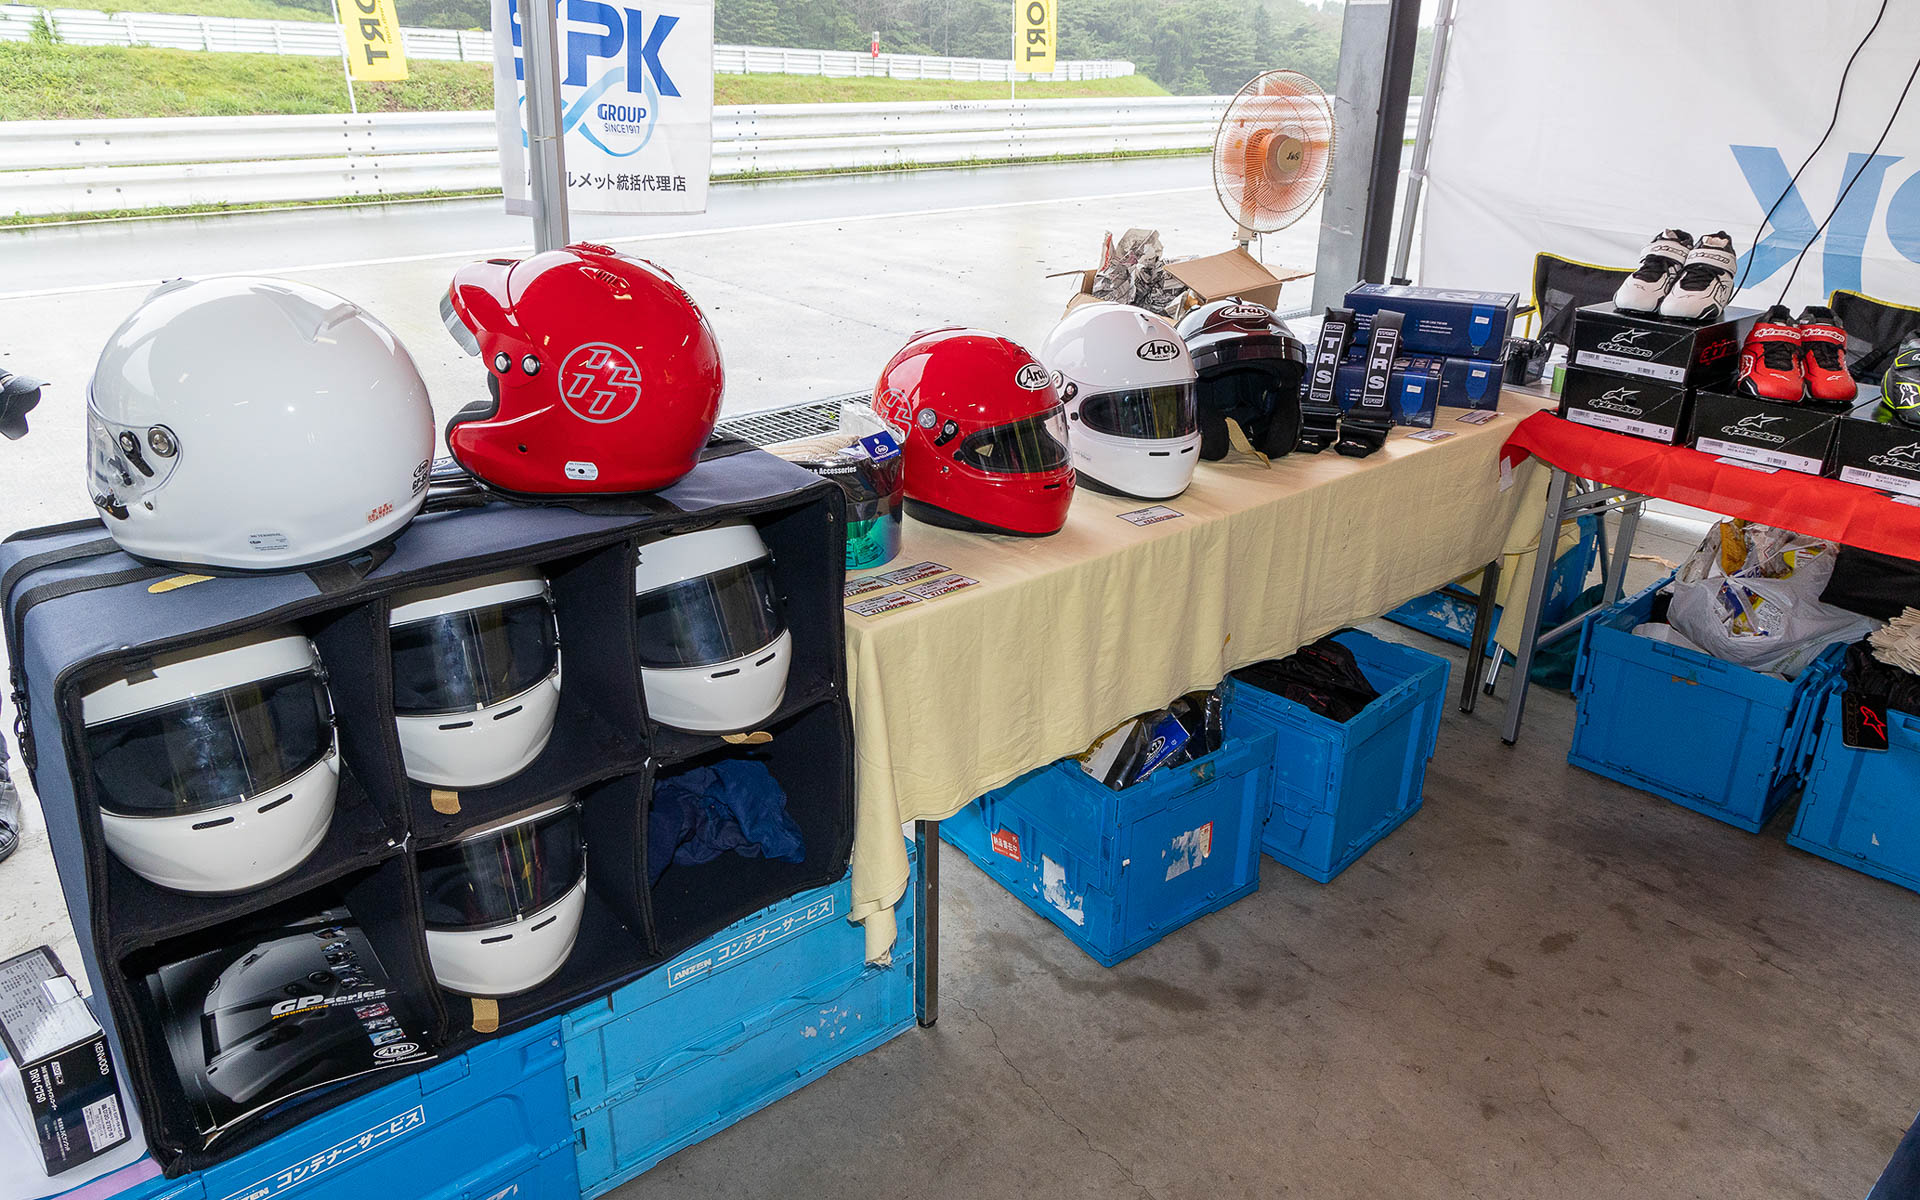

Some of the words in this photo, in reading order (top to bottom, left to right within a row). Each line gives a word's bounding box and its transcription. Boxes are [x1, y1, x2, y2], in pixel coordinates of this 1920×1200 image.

[598, 104, 647, 123] GROUP
[1227, 305, 1265, 317] Arai
[1142, 342, 1178, 358] Arai
[1316, 336, 1341, 384] TRS
[1024, 368, 1048, 386] Arai
[1368, 343, 1393, 390] TRS
[819, 466, 857, 475] Accessories
[674, 957, 713, 981] ANZEN
[717, 900, 831, 961] コンテナーサービス
[94, 1040, 110, 1076] KENWOOD
[378, 1045, 415, 1057] Arai
[28, 1068, 47, 1104] DRV-C750
[277, 1111, 421, 1189] コンテナーサービス
